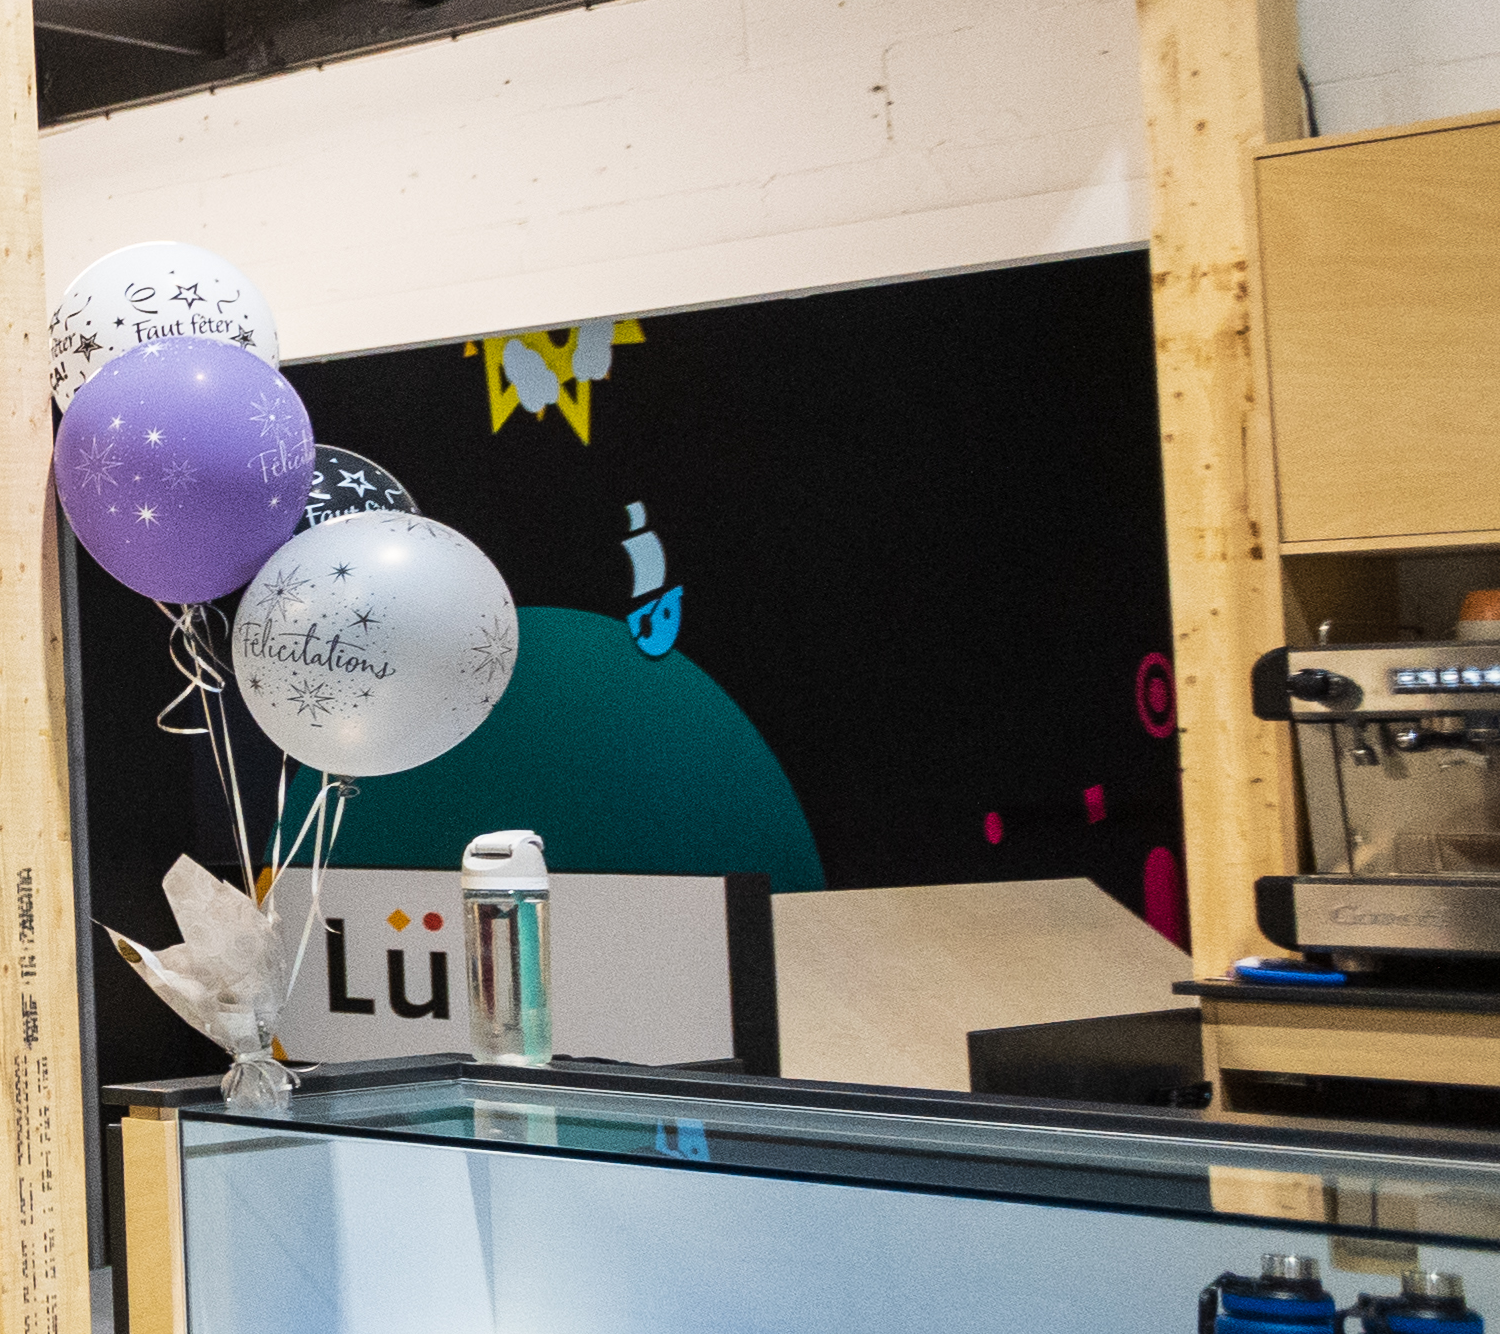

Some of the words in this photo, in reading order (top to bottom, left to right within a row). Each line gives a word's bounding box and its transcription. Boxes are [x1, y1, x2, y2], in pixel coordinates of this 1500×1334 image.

[132, 320, 185, 343] Faut
[191, 313, 234, 335] fêter
[239, 618, 397, 680] Félicitations
[326, 909, 450, 1020] Lü
